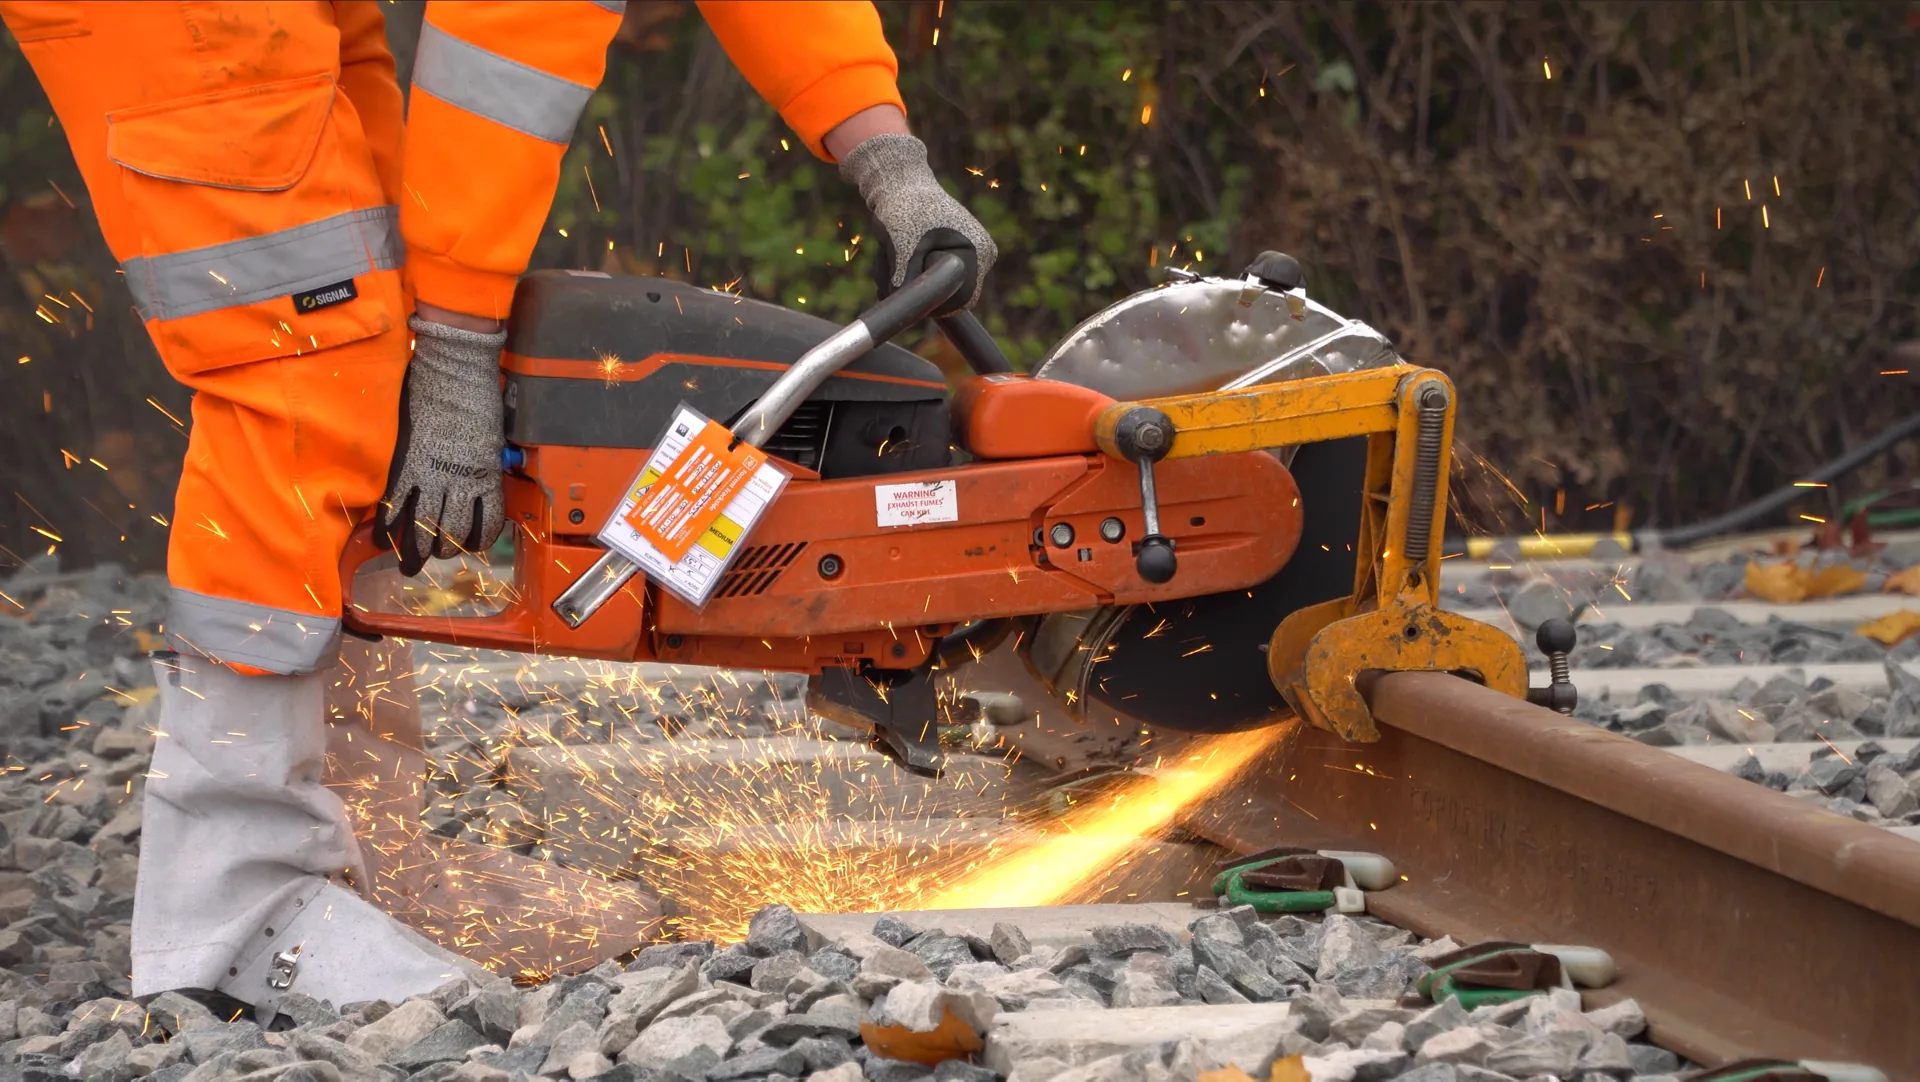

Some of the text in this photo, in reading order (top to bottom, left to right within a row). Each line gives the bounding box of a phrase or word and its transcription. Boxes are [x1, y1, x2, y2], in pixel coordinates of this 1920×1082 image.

[316, 287, 351, 305] SIGNAL
[429, 457, 472, 477] SIGNAL
[728, 468, 747, 488] Torrent
[708, 487, 731, 512] Trackside
[893, 490, 936, 499] WARNING
[887, 500, 918, 510] EXHAUST
[901, 509, 915, 517] CAN
[707, 526, 735, 546] MEDIUM
